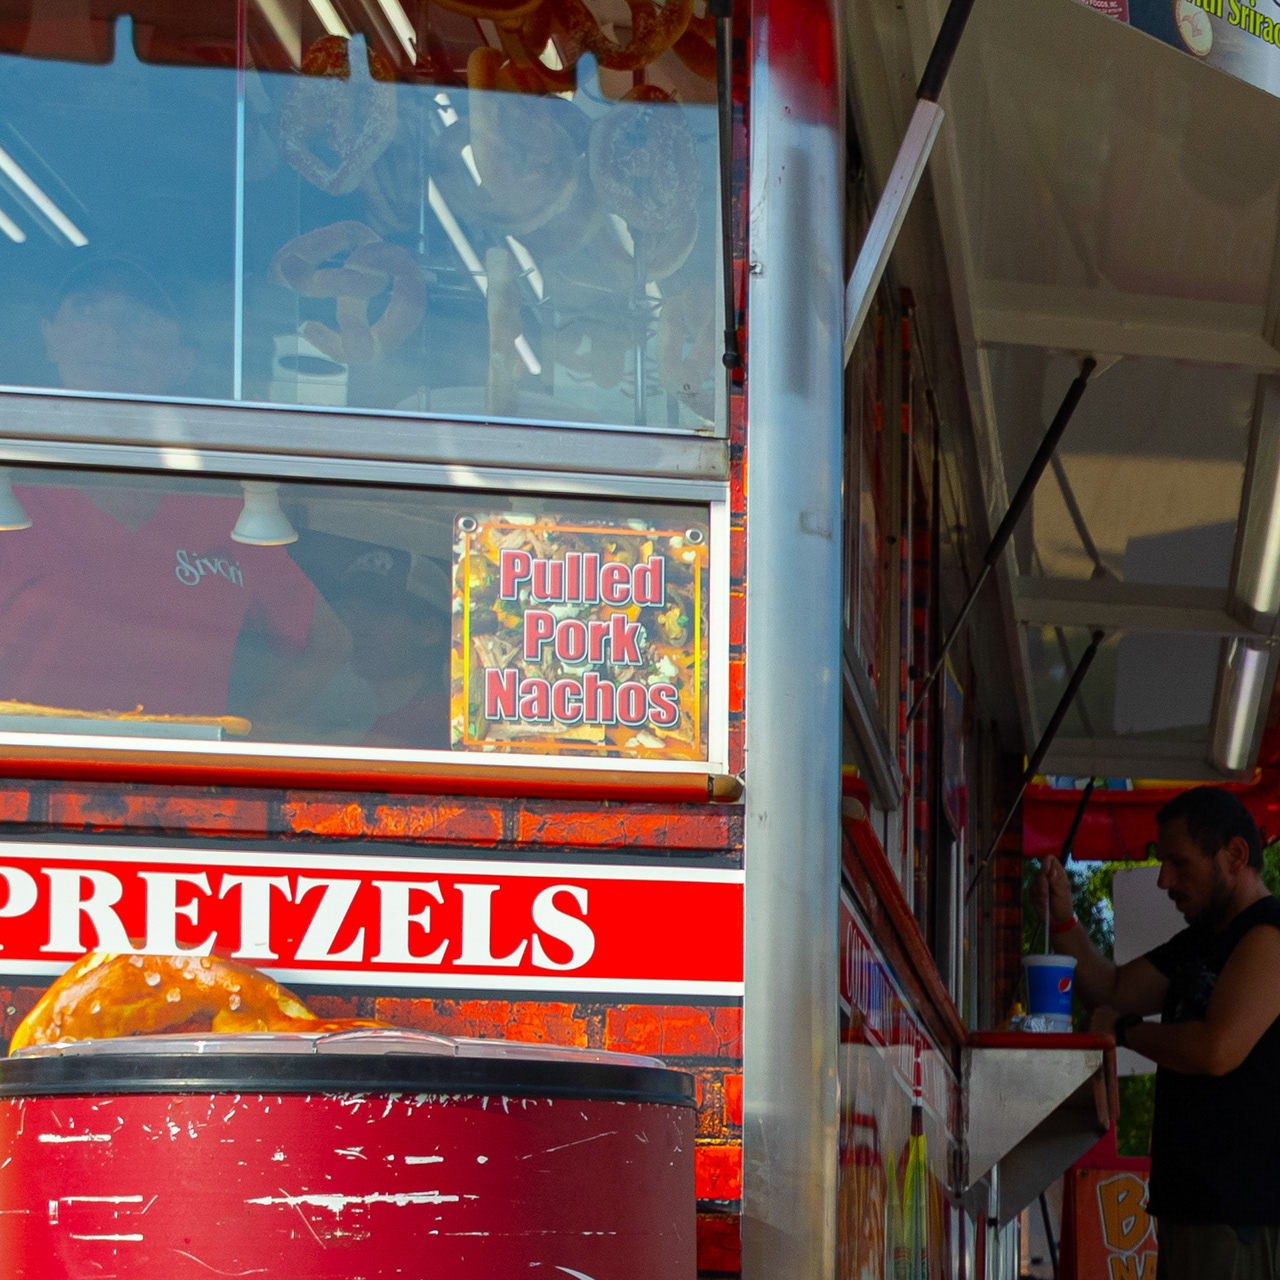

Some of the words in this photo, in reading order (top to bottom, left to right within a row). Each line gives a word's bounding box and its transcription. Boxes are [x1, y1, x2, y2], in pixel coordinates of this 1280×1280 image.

[500, 548, 665, 608] Pulled
[523, 609, 642, 666] Pork
[484, 667, 680, 728] Nachos
